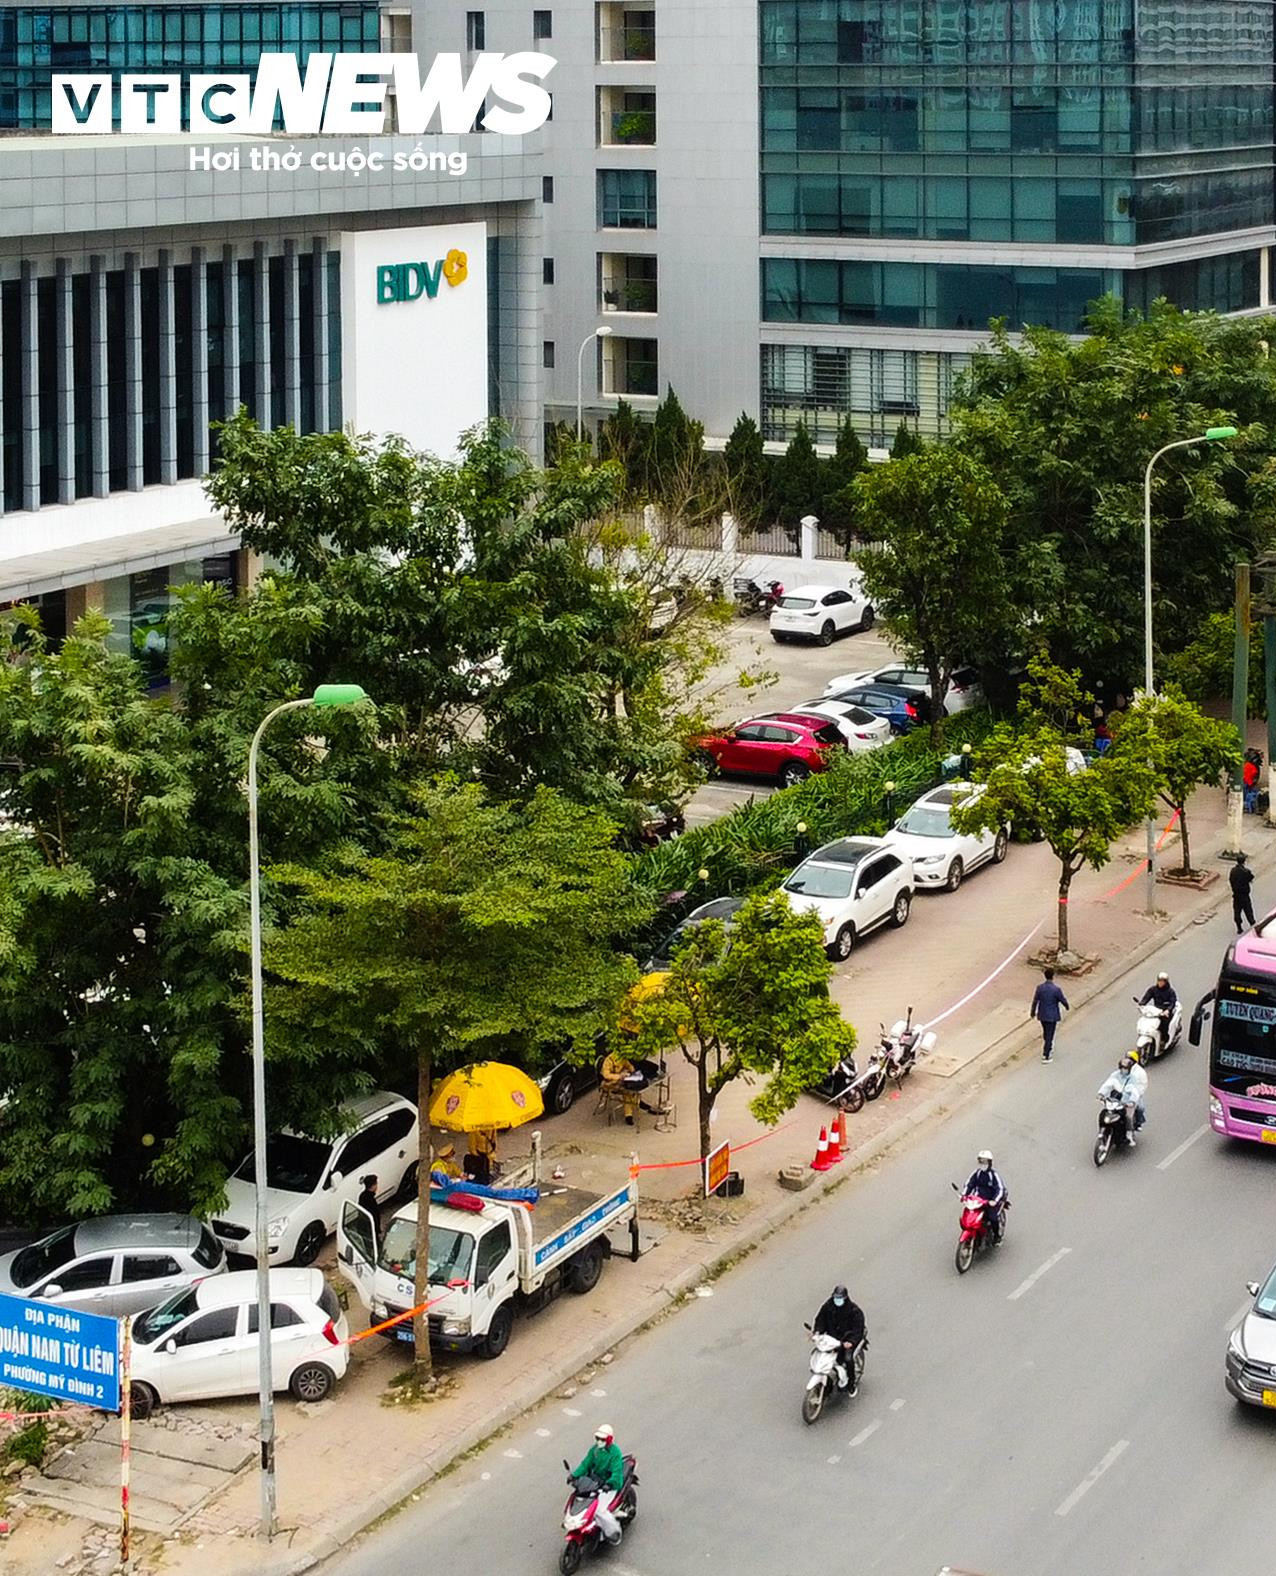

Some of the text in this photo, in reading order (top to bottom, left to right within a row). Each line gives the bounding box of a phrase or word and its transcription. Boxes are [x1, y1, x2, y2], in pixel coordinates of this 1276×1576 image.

[376, 259, 446, 305] BIDV
[25, 1307, 80, 1333] ĐỊA PHẬN
[31, 1334, 61, 1364] NAM
[63, 1339, 80, 1369] TỪ
[82, 1344, 115, 1376] LIÊM
[3, 1363, 104, 1399] PHƯỜNG MỸ ĐÌNH 2
